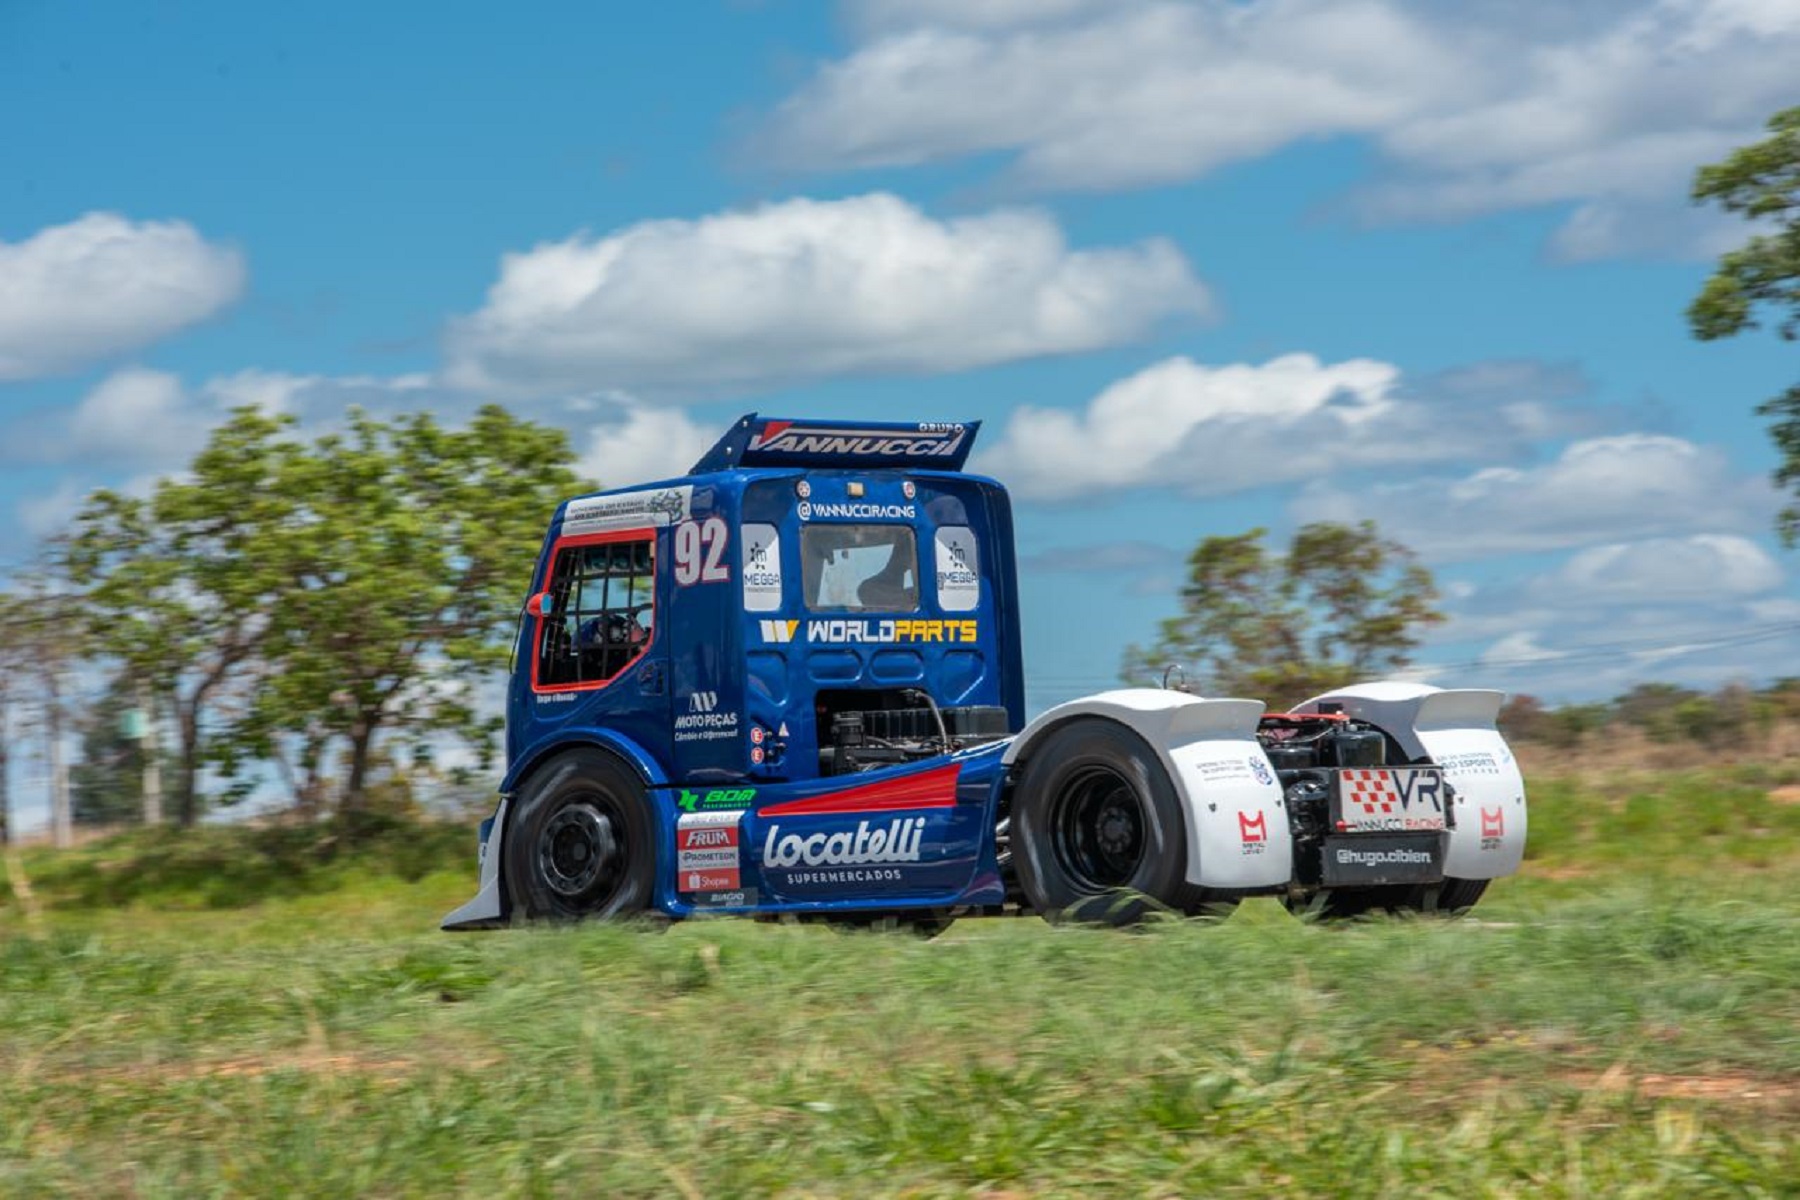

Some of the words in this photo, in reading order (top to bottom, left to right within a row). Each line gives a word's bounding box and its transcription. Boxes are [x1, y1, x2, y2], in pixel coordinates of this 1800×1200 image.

[919, 422, 964, 433] GRUPO
[674, 517, 730, 588] 92
[744, 572, 780, 586] MEGGA
[944, 571, 977, 584] MEGGA
[807, 619, 977, 643] WORLDPARTS
[674, 714, 704, 729] MOTO
[704, 711, 738, 729] PEÇAS
[1391, 769, 1442, 813] VR
[1404, 818, 1444, 831] RACING
[686, 831, 731, 847] FRUM
[1336, 849, 1432, 867] @hugo.cibien
[787, 869, 902, 885] SUPERMERCADOS
